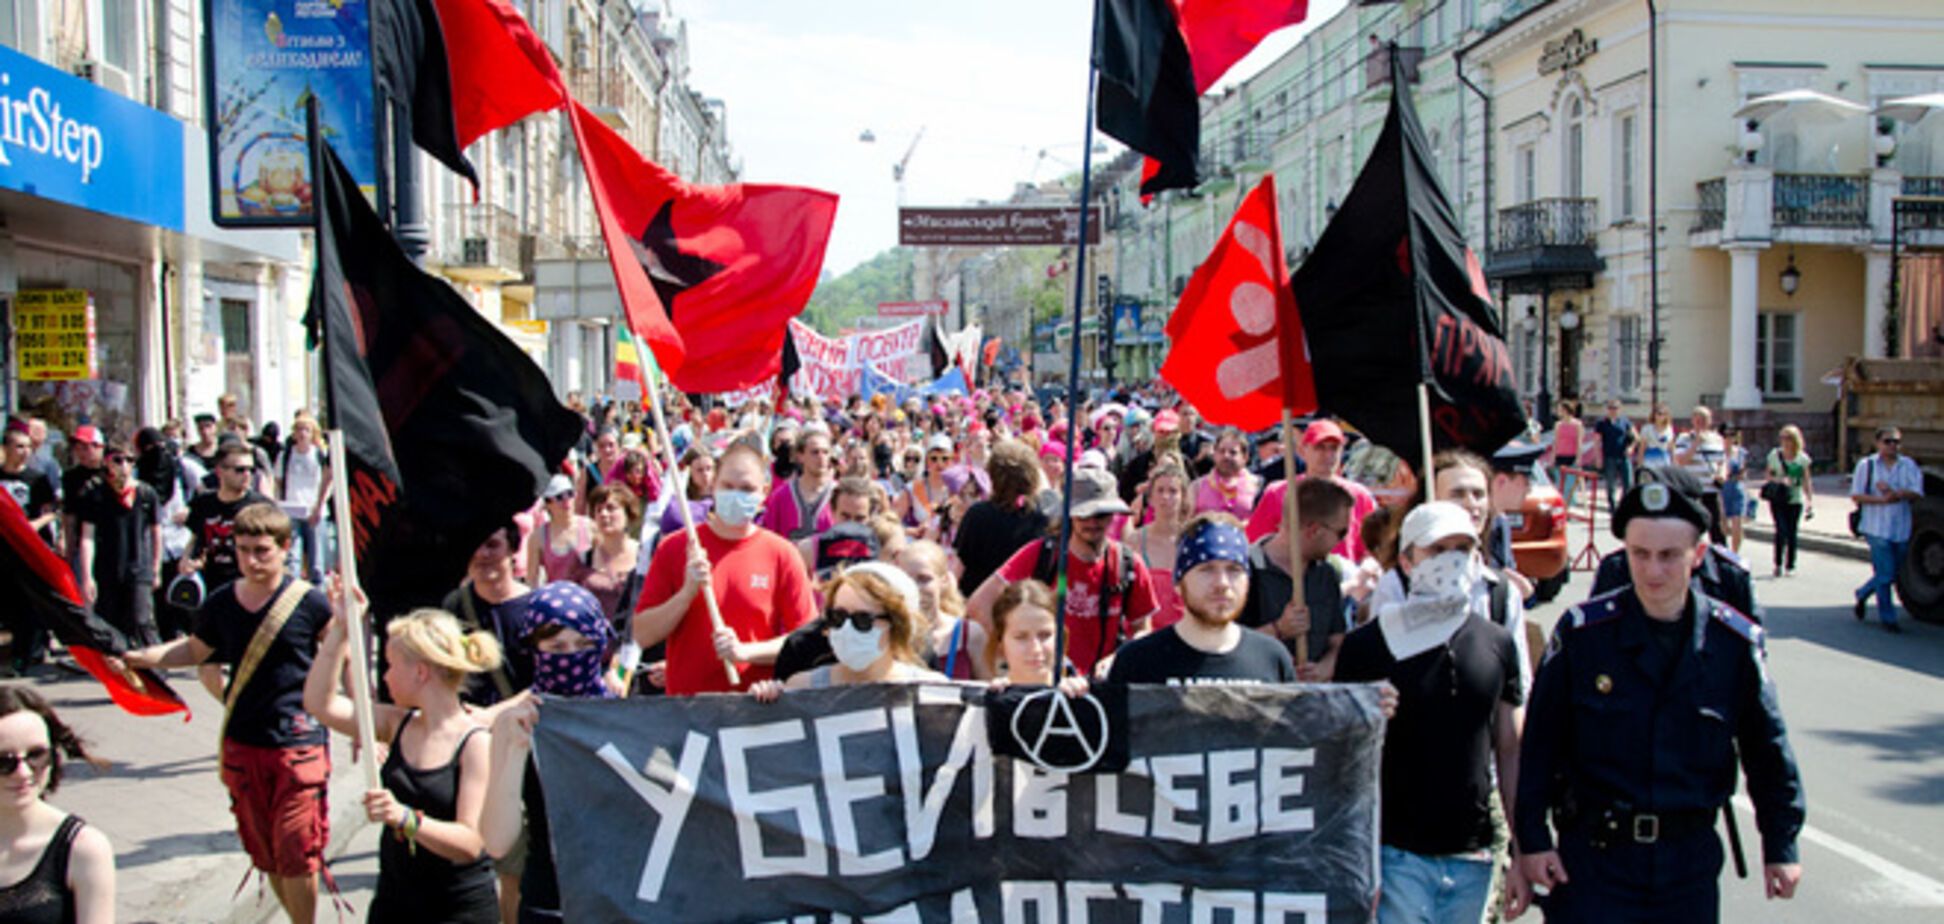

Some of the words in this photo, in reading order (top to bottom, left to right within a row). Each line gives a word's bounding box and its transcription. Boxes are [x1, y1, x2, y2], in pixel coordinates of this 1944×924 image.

[0, 72, 103, 184] irStep
[596, 685, 995, 902] УБЕЙ
[1094, 746, 1315, 844] СЕБЕ
